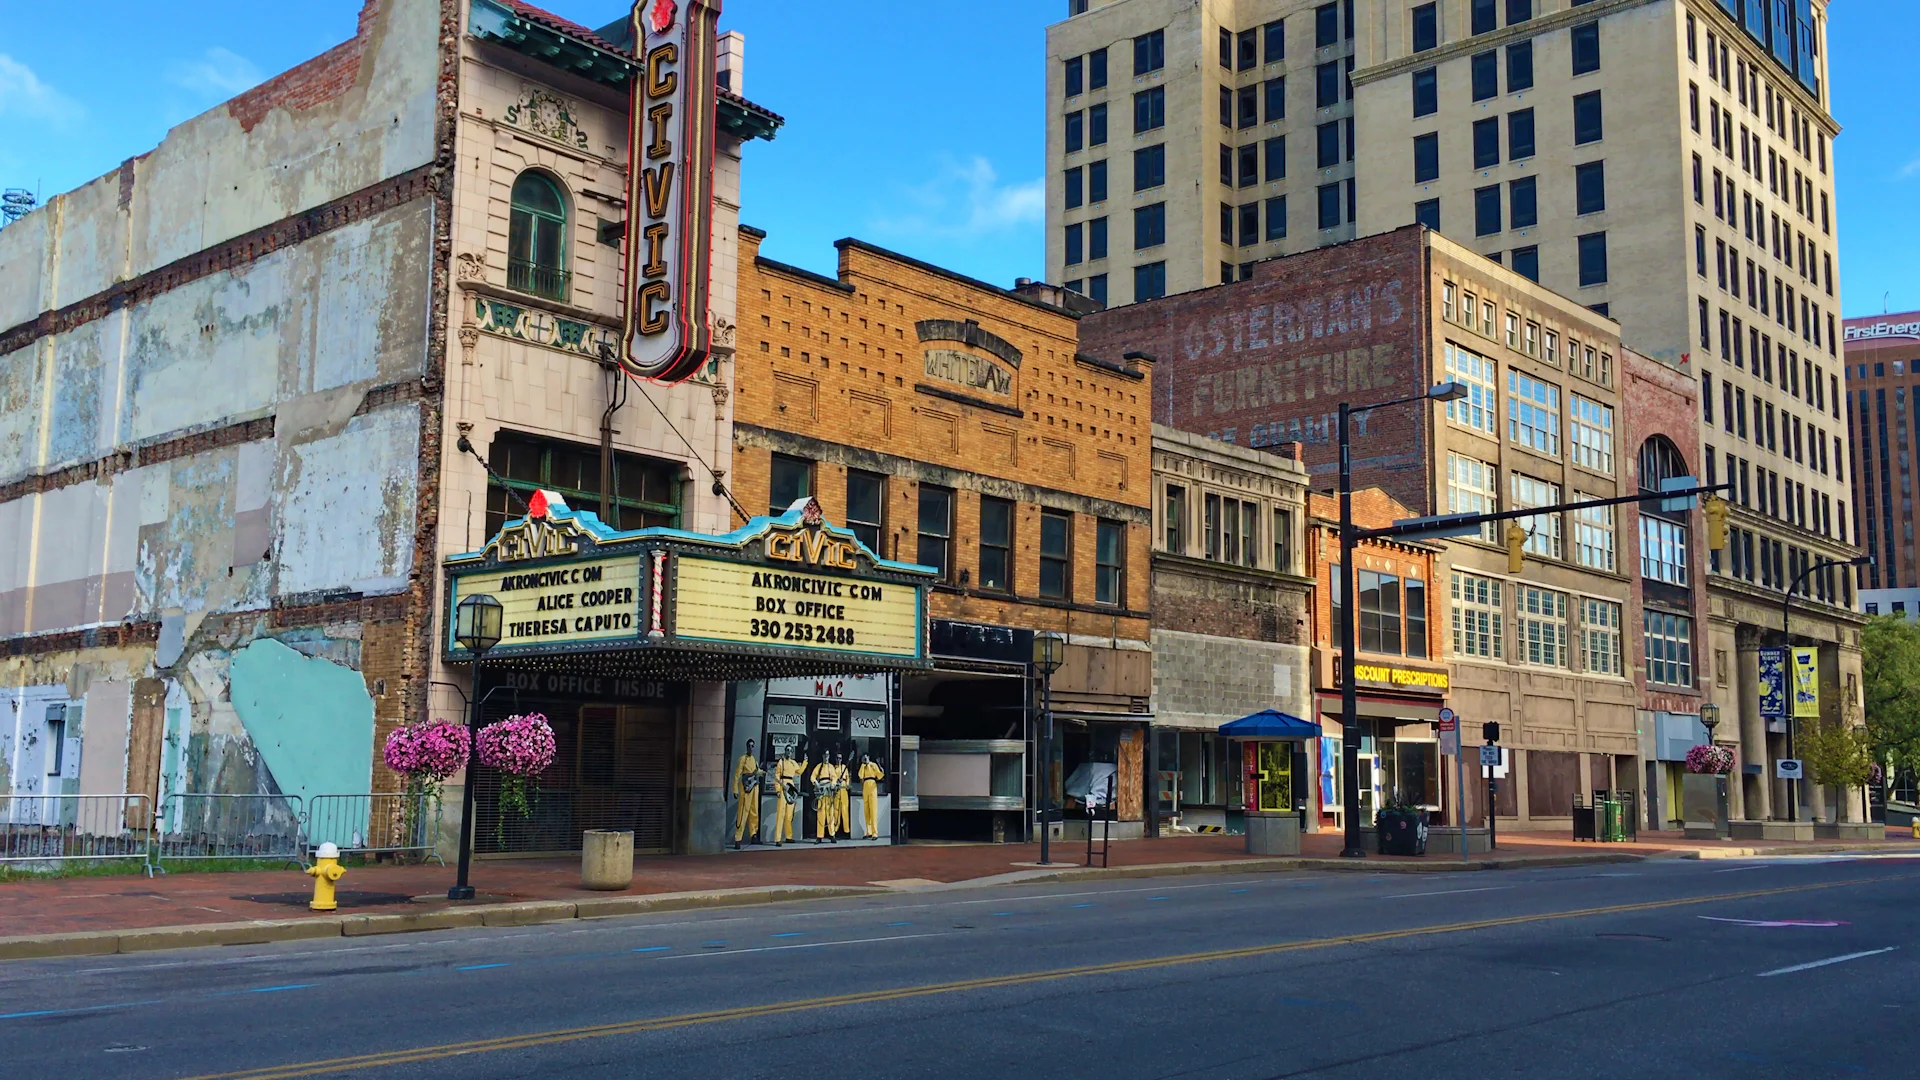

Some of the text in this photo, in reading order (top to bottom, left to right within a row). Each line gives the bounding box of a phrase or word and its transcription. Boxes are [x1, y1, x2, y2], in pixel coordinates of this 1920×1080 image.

[637, 41, 678, 337] CIVIC
[1844, 322, 1920, 340] FirstEnerg
[926, 351, 1012, 395] WHITELAW
[1193, 342, 1396, 417] FURNITURE
[497, 521, 579, 562] CIVIC
[765, 528, 857, 570] CIVIC
[501, 569, 568, 592] AKRONCIVIC
[752, 571, 882, 602] AKRONCIVIC COM
[537, 588, 632, 611] ALICE COOPER
[756, 596, 845, 620] BOX OFFICE
[509, 613, 631, 638] THERESA CAPUTO
[750, 618, 855, 645] 330 253 2488
[506, 672, 665, 698] BOX OFFICE INSIDE
[815, 680, 844, 697] MAC
[1392, 668, 1448, 688] PRESCRIPTIONS
